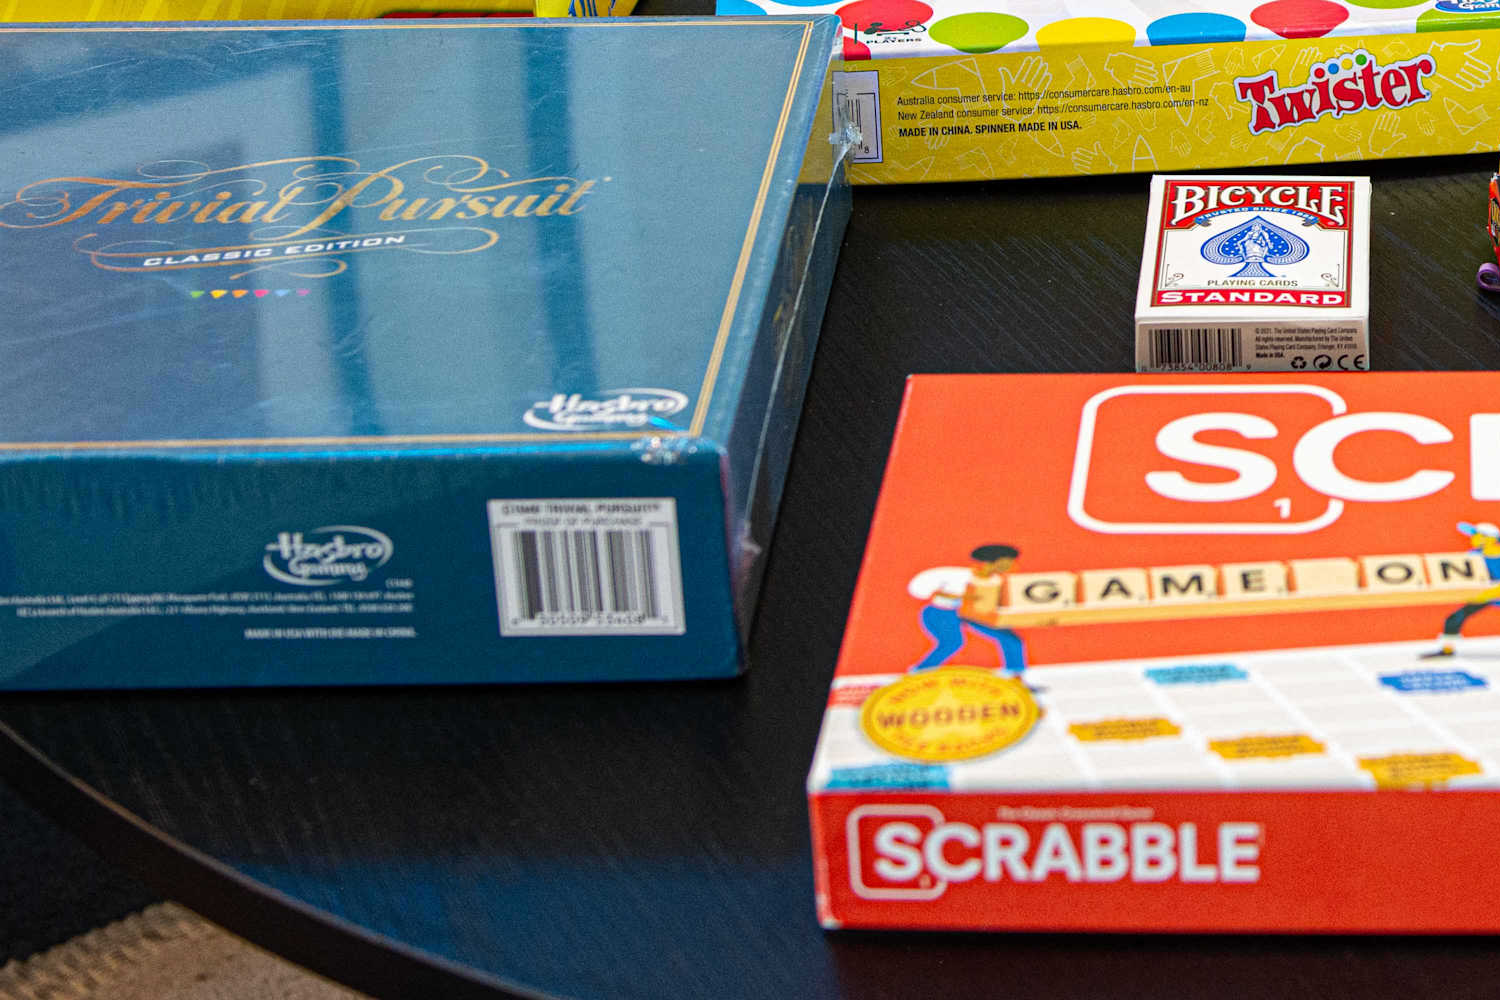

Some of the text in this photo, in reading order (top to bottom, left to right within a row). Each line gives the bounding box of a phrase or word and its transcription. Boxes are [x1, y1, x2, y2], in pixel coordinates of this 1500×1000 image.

[898, 83, 1192, 106] Australia consumer service: https://consumercare.hasbro.com/en-au
[1237, 56, 1433, 134] Twister
[898, 97, 1210, 121] New Zealand consumer service: https://consumercare.hasbro.com/en-nz
[899, 119, 1084, 138] MADE IN CHINA. SPINNER MADE IN USA.
[0, 156, 598, 238] Trivial Pursuit
[1169, 184, 1346, 228] BICYCLE
[1200, 206, 1250, 220] TRUSTED
[142, 233, 408, 268] CLASSIC EDITION
[1206, 279, 1299, 288] PLAYING CARDS
[1161, 291, 1343, 306] STANDARD
[534, 392, 680, 415] Hasbro
[266, 531, 386, 562] Hasbro
[287, 555, 370, 582] Gaming
[1376, 558, 1475, 587] ON
[876, 702, 1022, 730] WOODEN
[873, 820, 1262, 884] SCRABBLE
